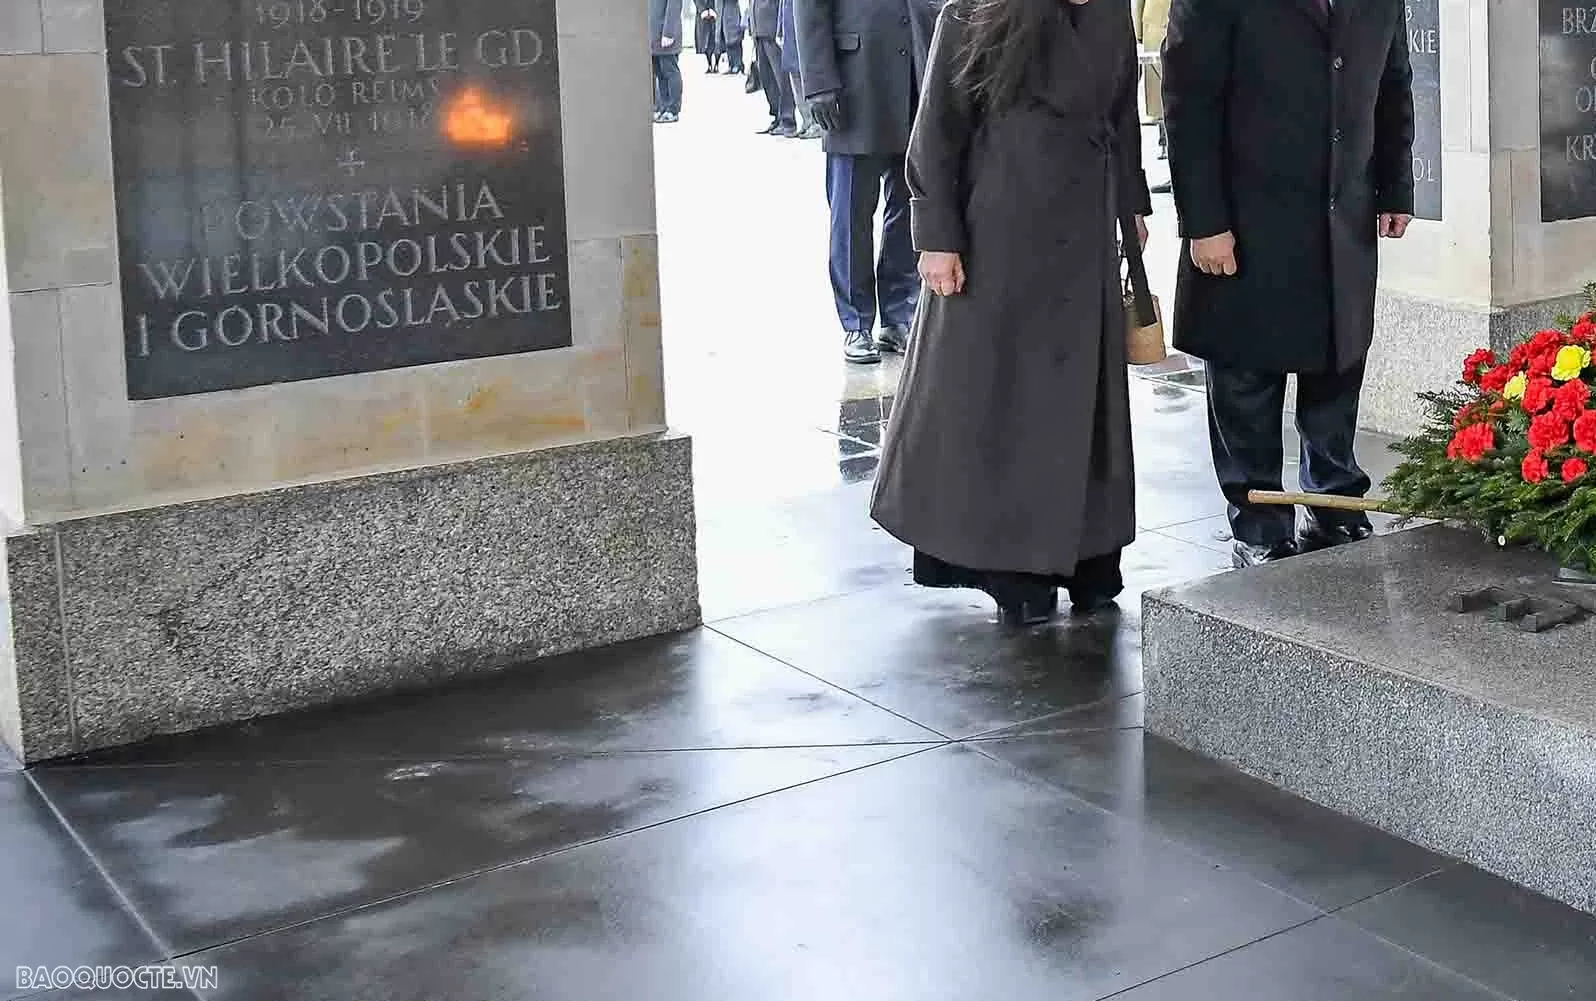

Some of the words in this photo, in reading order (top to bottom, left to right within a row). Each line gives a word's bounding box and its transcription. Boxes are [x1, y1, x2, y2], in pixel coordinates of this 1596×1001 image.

[194, 30, 402, 83] HILAIRE
[413, 30, 460, 73] LE
[201, 180, 505, 242] POWSTANIA
[137, 225, 553, 302] WIELKOPOLSKIE
[138, 313, 152, 358] I
